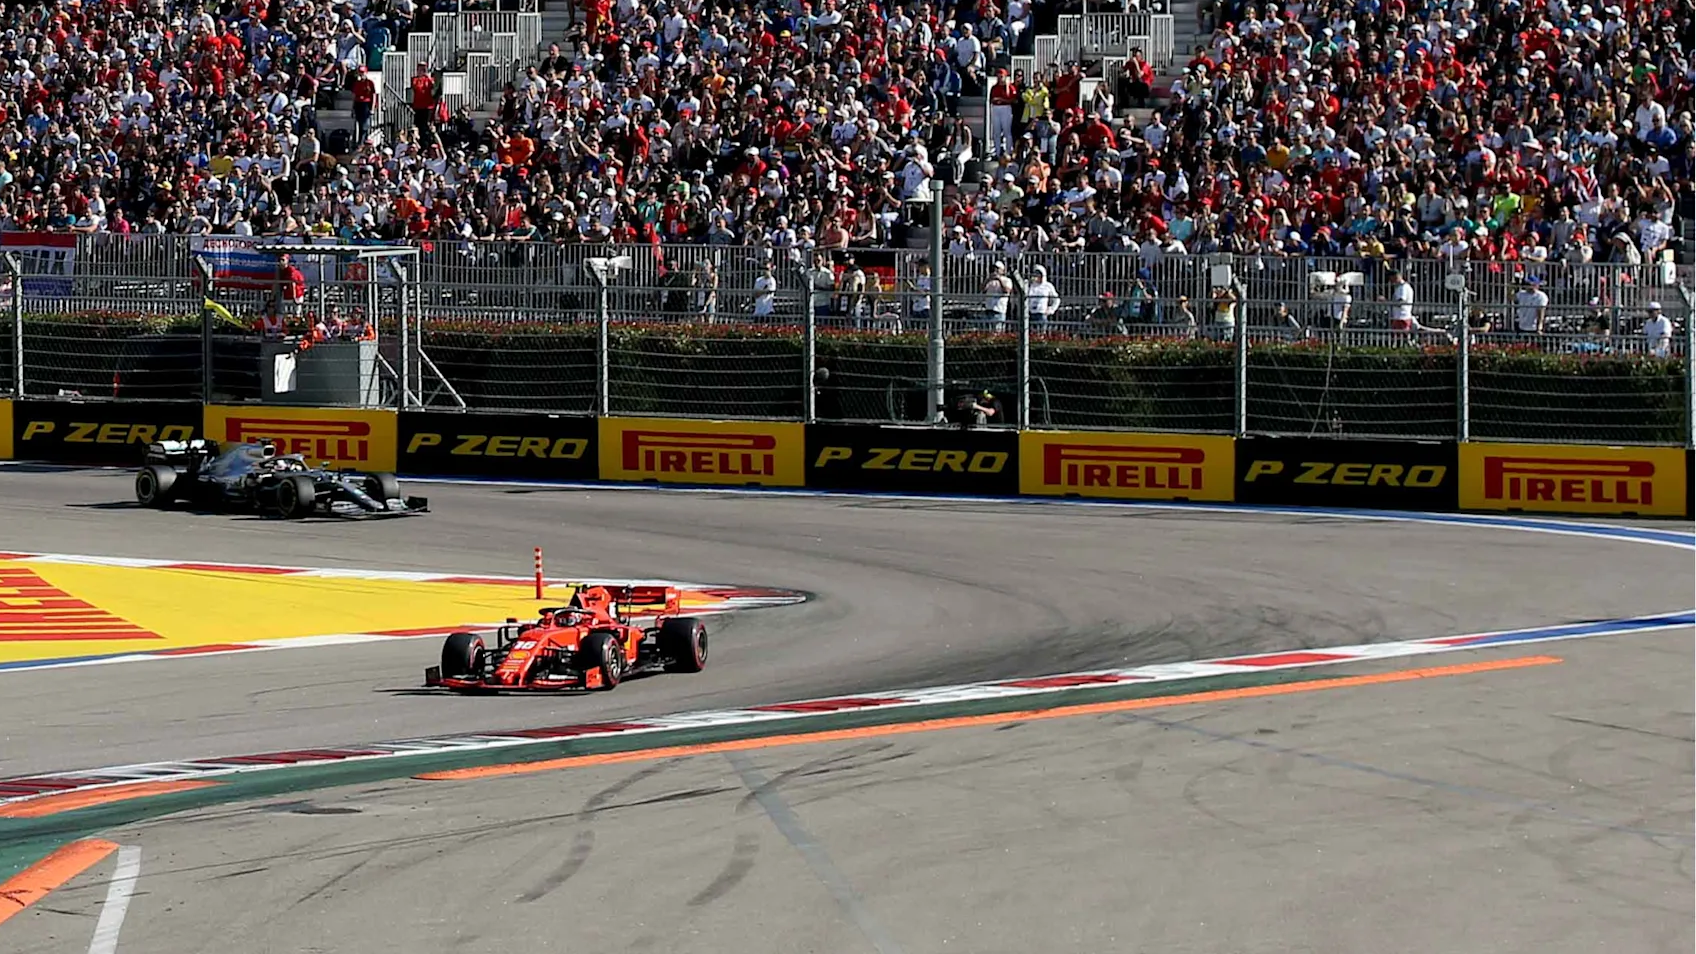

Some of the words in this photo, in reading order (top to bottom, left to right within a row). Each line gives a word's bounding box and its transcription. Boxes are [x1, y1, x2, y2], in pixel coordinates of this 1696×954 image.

[22, 421, 55, 441] P
[63, 422, 194, 444] ZERO
[225, 417, 371, 461] PRELLI
[407, 433, 442, 453] P
[452, 434, 589, 459] ZERO
[622, 430, 776, 476] PIRELLI
[815, 447, 853, 468] P
[864, 448, 1008, 473] ZERO
[1043, 443, 1205, 490] PIRELLI
[1244, 460, 1284, 482] P
[1293, 461, 1447, 488] ZERO
[1484, 456, 1655, 506] PIRELLI
